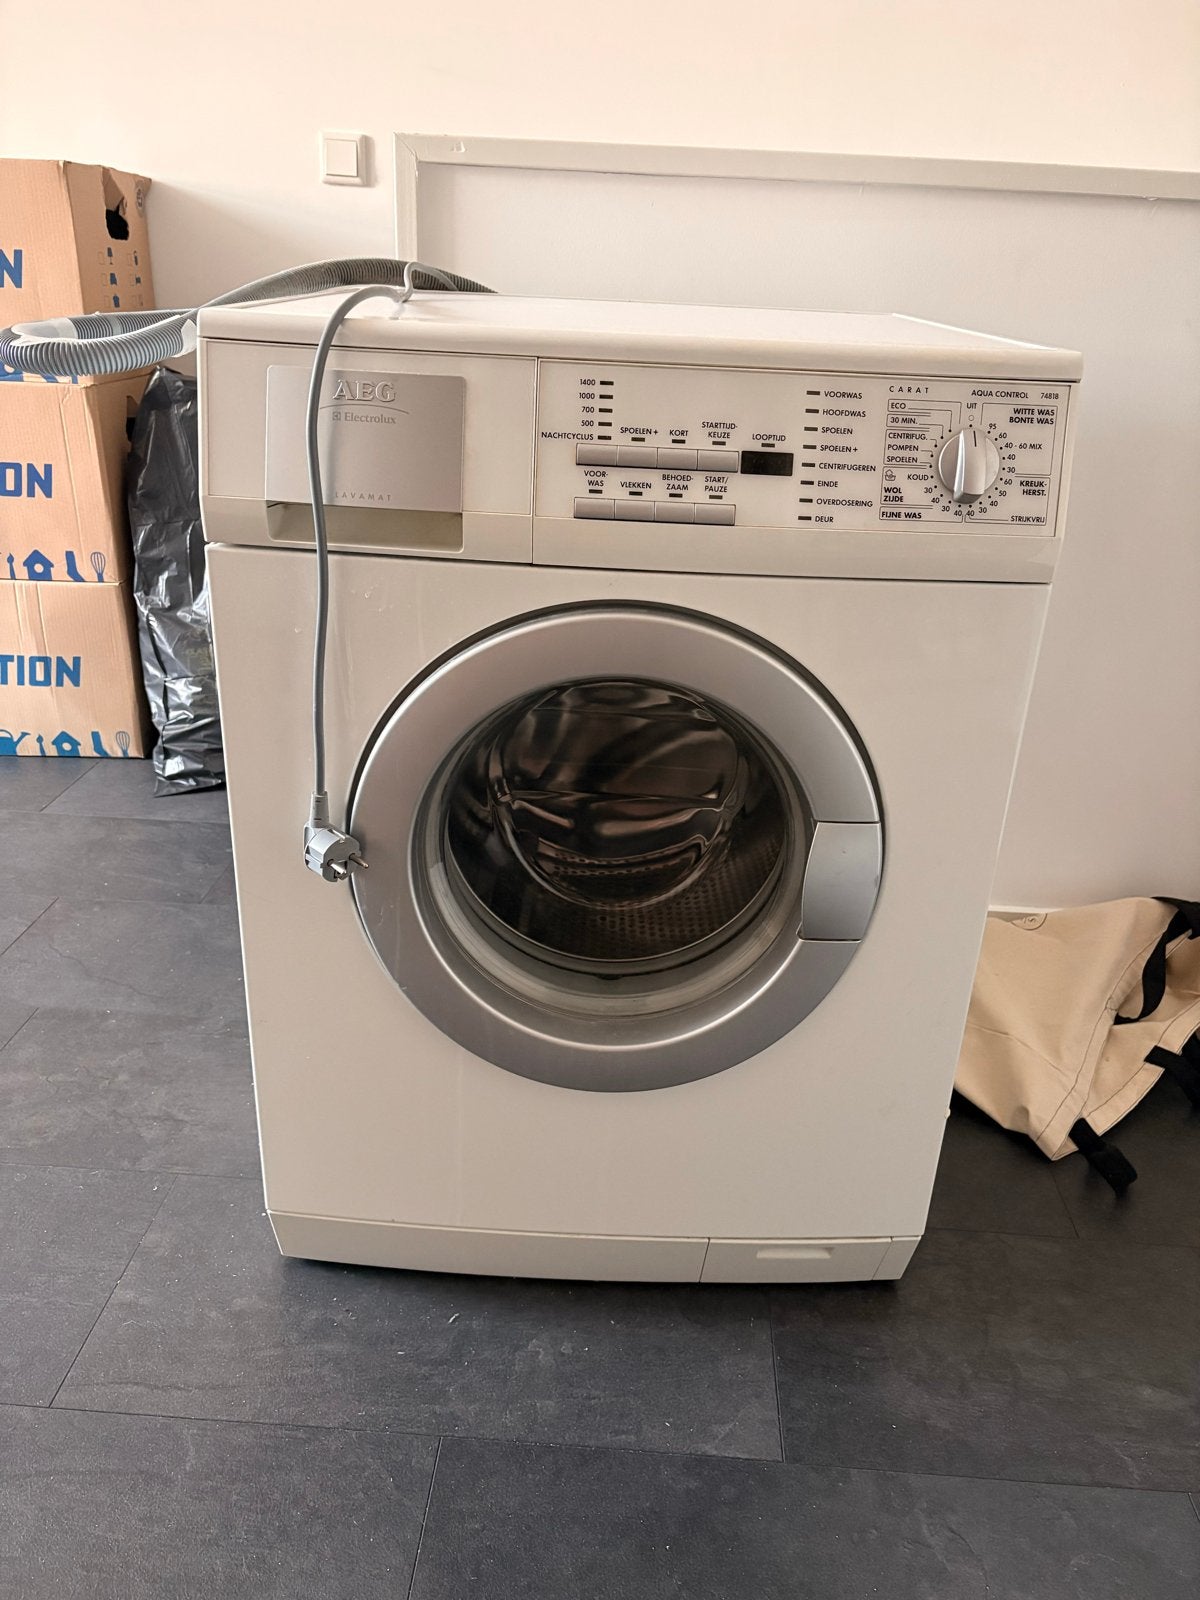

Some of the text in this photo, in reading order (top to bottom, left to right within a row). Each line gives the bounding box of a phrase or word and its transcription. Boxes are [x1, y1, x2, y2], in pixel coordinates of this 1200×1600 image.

[580, 378, 596, 386] 1400
[332, 379, 397, 403] AEG
[888, 385, 929, 394] CARAT
[579, 392, 596, 400] 1000
[824, 390, 863, 400] VOORWAS
[971, 389, 1029, 399] AQUA CONTROL
[1040, 392, 1059, 400] 74818
[890, 402, 907, 410] ECO
[822, 408, 867, 418] HOOFDWAS
[1013, 407, 1055, 416] WITTE WAS
[344, 411, 397, 425] Electrolux
[890, 416, 918, 425] 30 MIN.
[1009, 416, 1054, 425] BONTE WAS
[581, 419, 595, 427] 500
[701, 421, 738, 430] STARTTIJD-
[620, 427, 652, 435] SPOELEN
[669, 429, 688, 437] KORT
[821, 426, 854, 435] SPOELEN
[541, 431, 594, 441] NACHTCYCLUS
[708, 431, 731, 439] KEUZE
[752, 433, 787, 442] LOOPTIJD
[888, 432, 928, 441] CENTRIFUG.
[820, 444, 852, 453] SPOELEN
[887, 444, 919, 452] POMPEN
[886, 455, 918, 464] SPOELEN
[1007, 453, 1016, 461] 40
[818, 462, 877, 472] CENTRIFUGEREN
[1006, 466, 1016, 474] 30
[583, 470, 609, 478] VOOR-
[661, 473, 694, 482] BEHOED-
[907, 473, 930, 481] KOUD
[0, 461, 53, 499] ON
[704, 475, 729, 485] START/
[817, 480, 839, 488] EINDE
[1003, 478, 1013, 486] 60
[1019, 480, 1047, 488] KREUK-
[620, 481, 652, 489] VLEKKEN
[666, 483, 689, 491] ZAAM
[704, 485, 728, 493] PAUZE
[335, 491, 391, 502] LAVAMAT
[816, 498, 873, 508] OVERDOSERING
[978, 506, 988, 514] 30
[814, 515, 834, 523] DEUR
[881, 511, 902, 519] FIJNE
[1010, 515, 1046, 523] STRIJKVRIJ
[0, 654, 82, 688] TION
